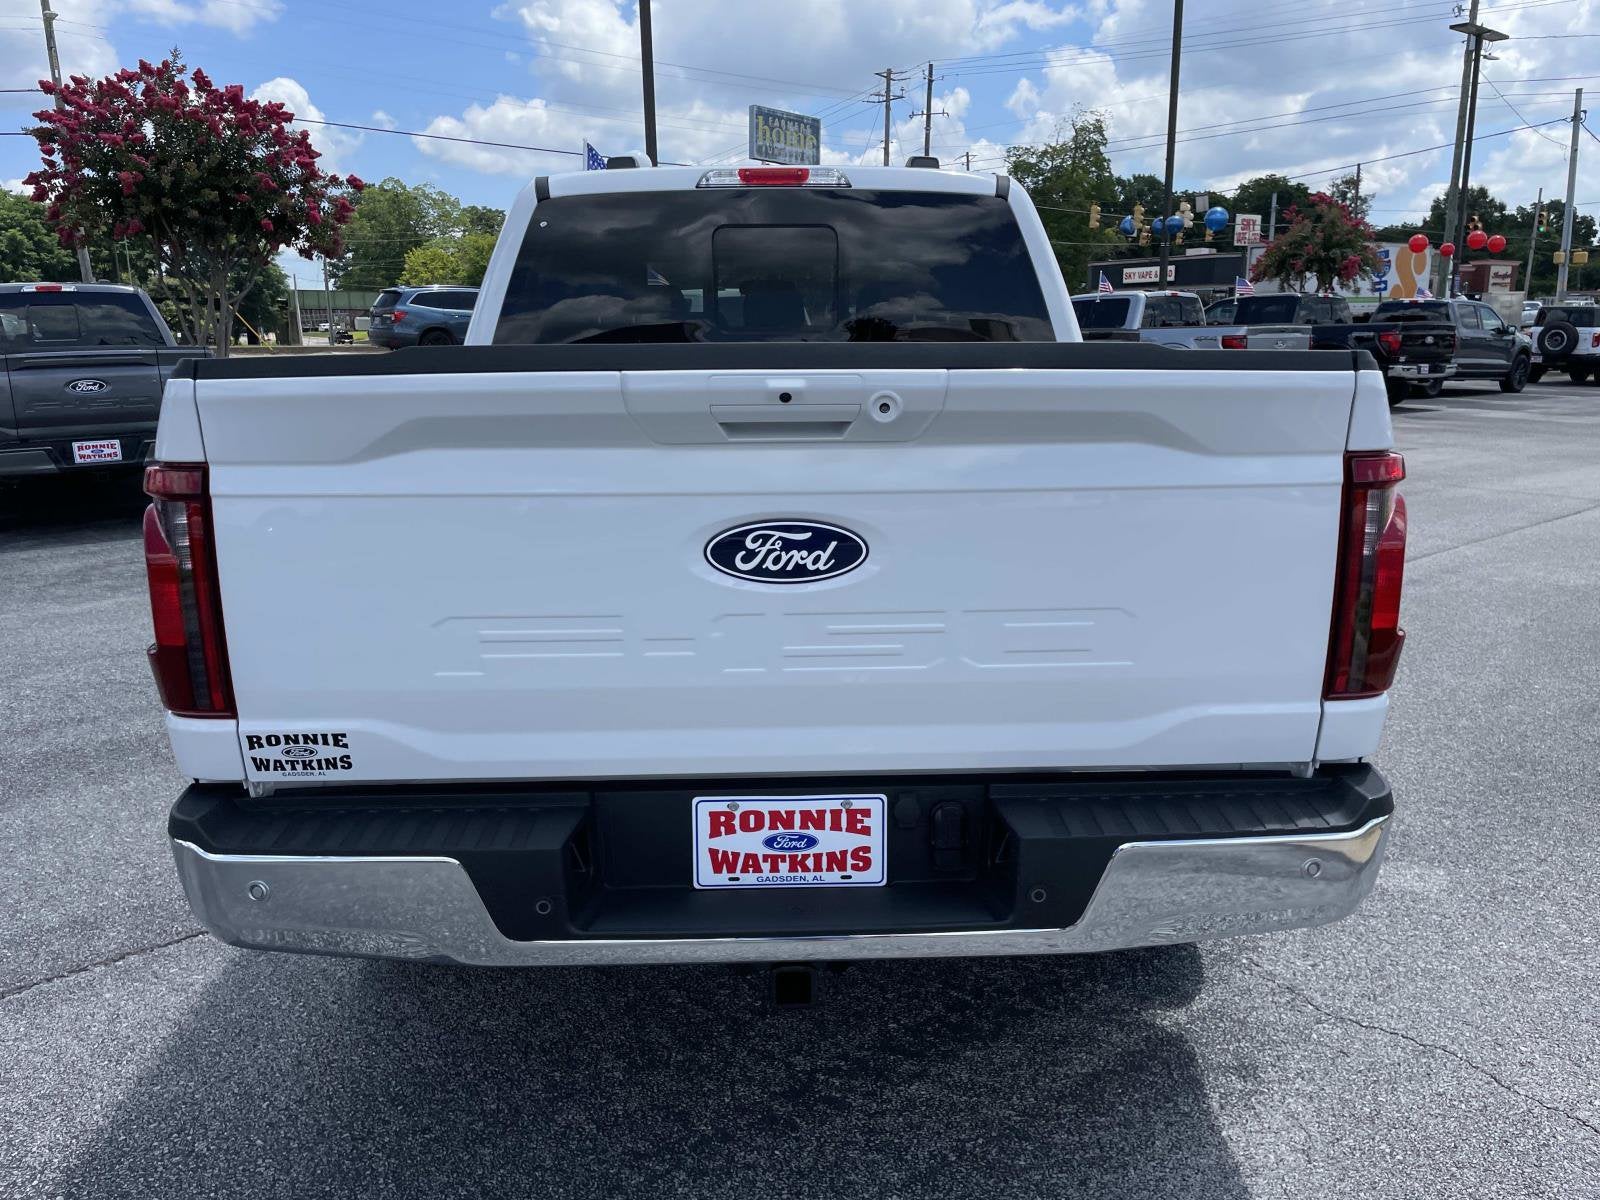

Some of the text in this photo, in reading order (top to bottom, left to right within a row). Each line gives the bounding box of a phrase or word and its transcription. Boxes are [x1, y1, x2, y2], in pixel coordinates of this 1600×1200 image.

[758, 115, 817, 149] home
[1241, 218, 1257, 231] SKY
[1124, 272, 1136, 280] SKY
[1138, 271, 1153, 279] VAPE
[78, 443, 117, 452] RONNIE
[78, 451, 118, 460] WATKINS
[735, 530, 838, 571] Ford
[246, 733, 349, 750] RONNIE
[251, 754, 352, 771] WATKINS
[709, 808, 871, 839] RONNIE
[773, 833, 808, 849] Ford
[708, 845, 872, 874] WATKINS
[756, 875, 809, 883] GADSDEN,
